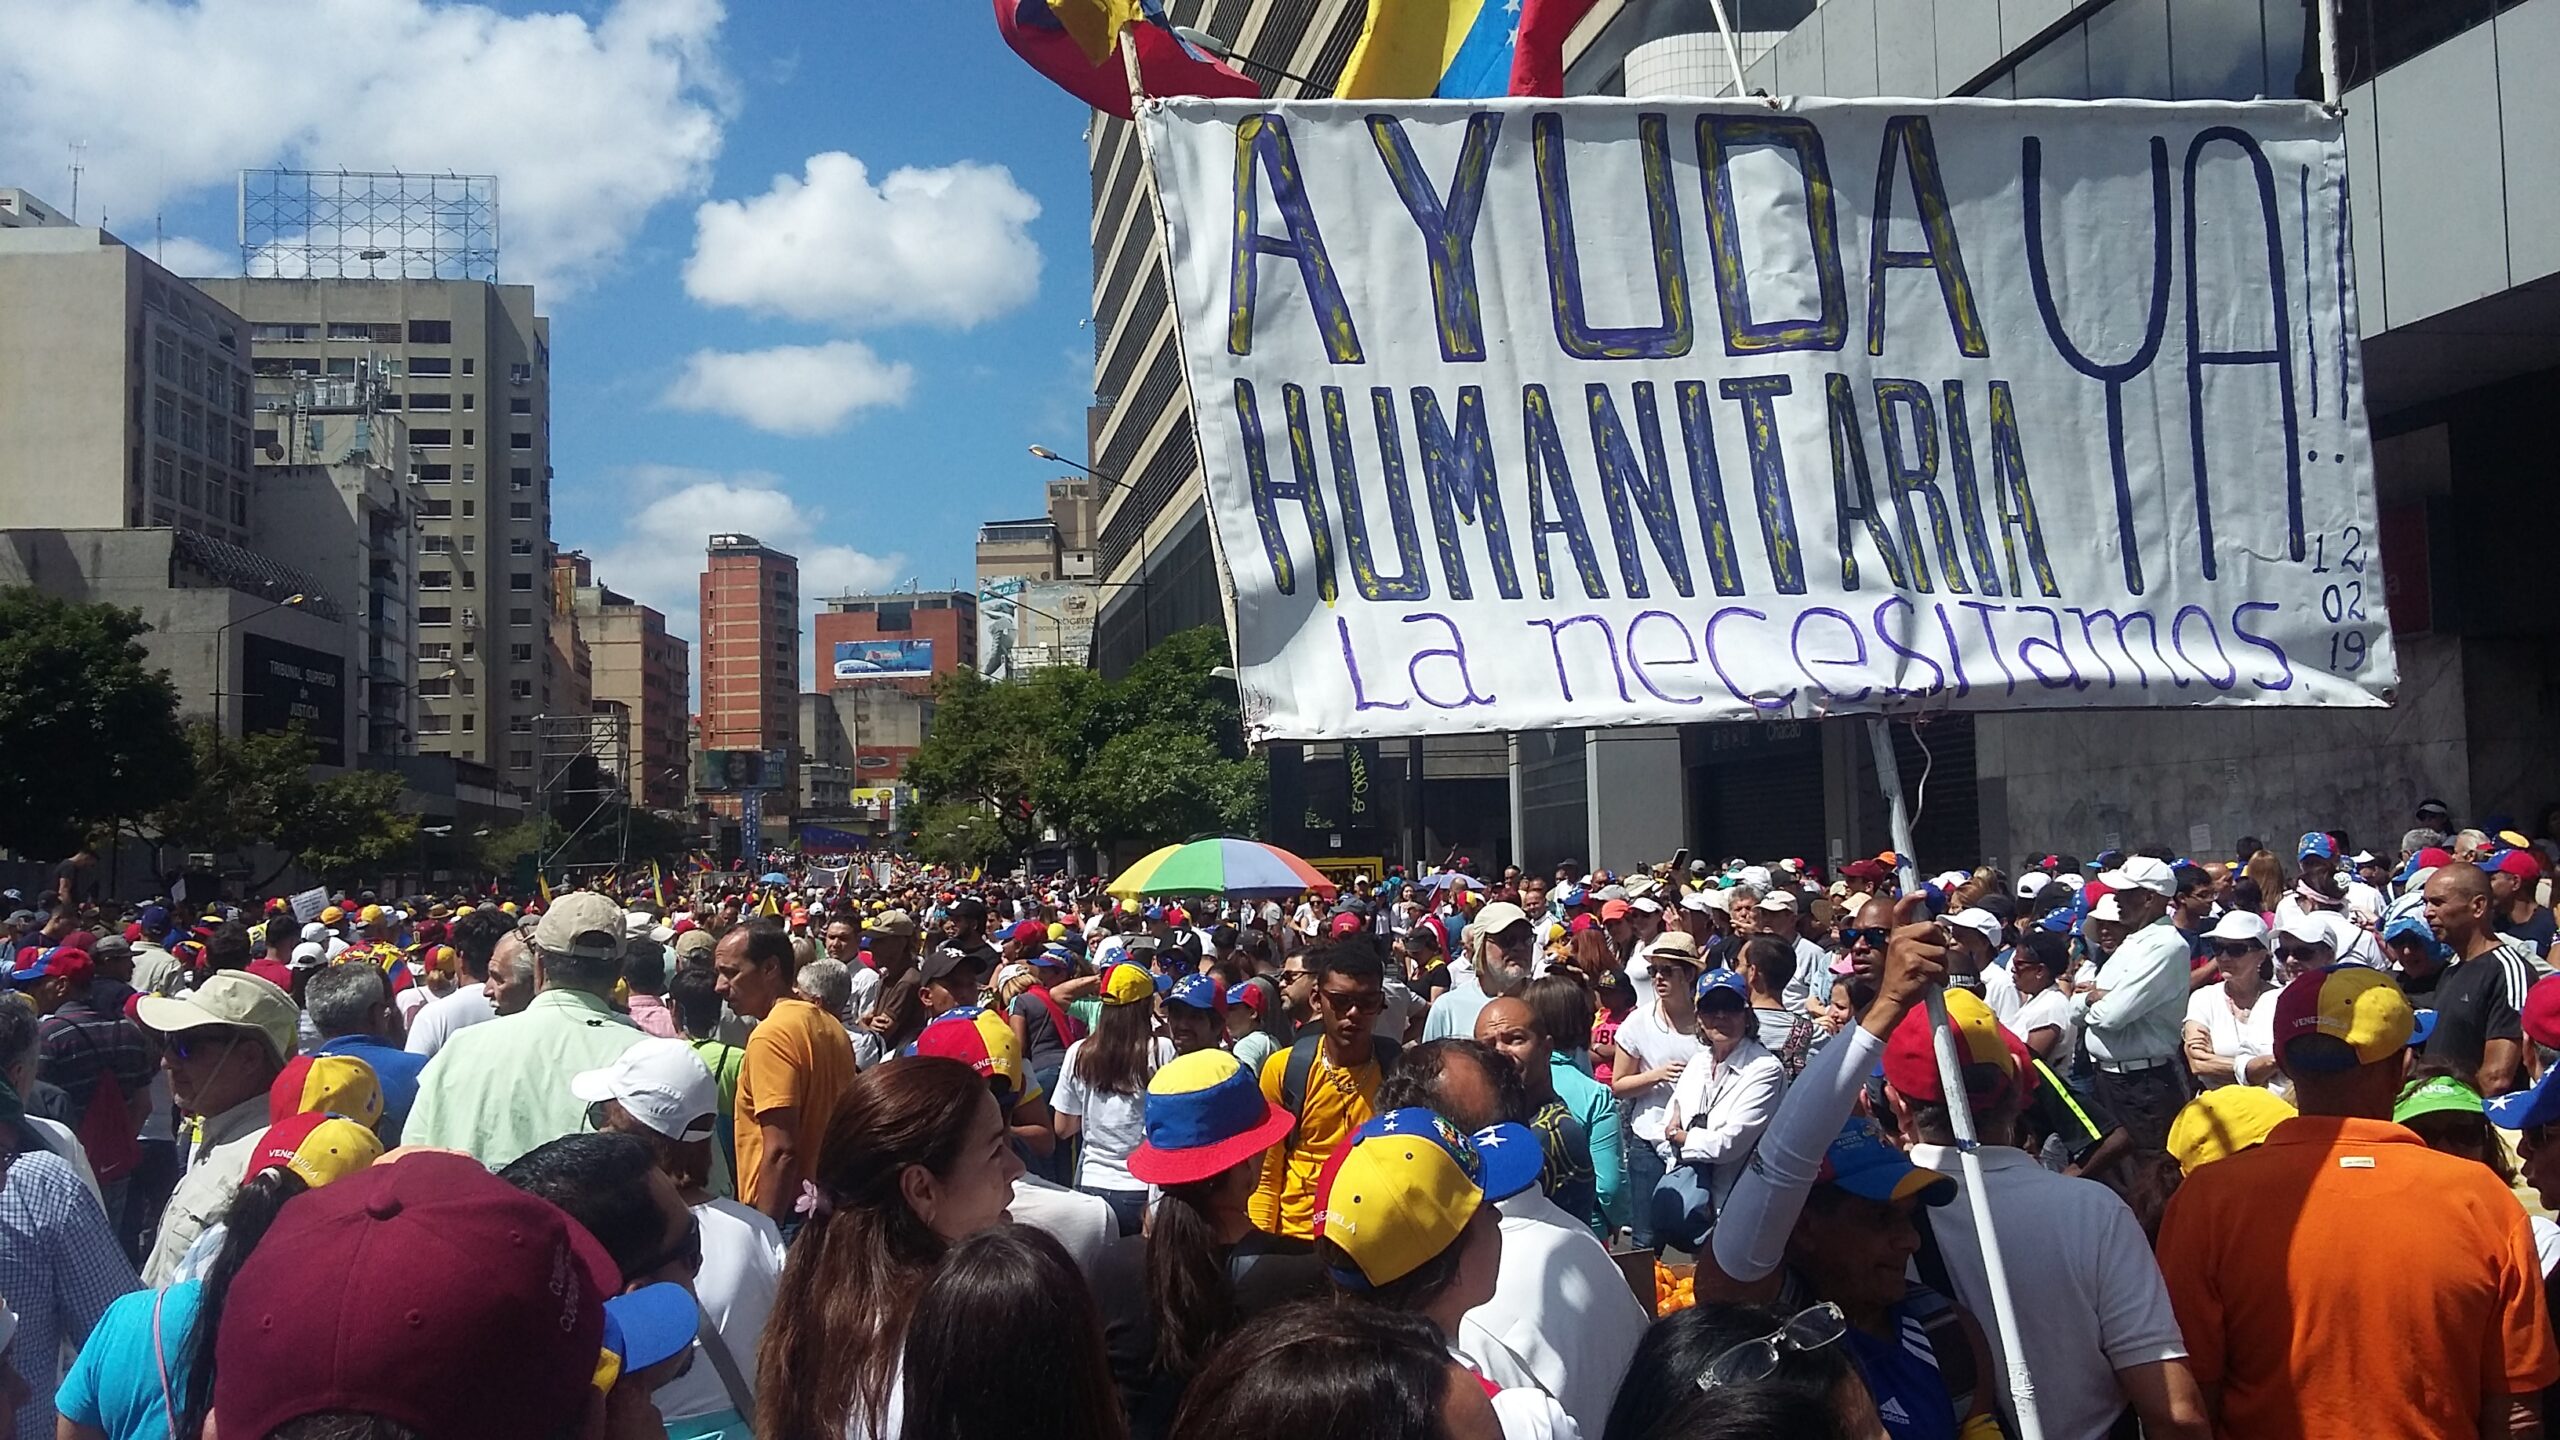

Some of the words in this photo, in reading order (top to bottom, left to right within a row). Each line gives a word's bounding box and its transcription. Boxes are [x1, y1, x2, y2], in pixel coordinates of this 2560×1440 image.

[1227, 112, 1989, 364] AYUDA
[1235, 373, 2061, 606] HUMANITARIA
[2322, 580, 2367, 623] 02
[1337, 612, 1496, 711] La
[2330, 630, 2366, 671] 19
[269, 660, 303, 680] TRIBUNAL
[305, 668, 336, 688] SUPREMO
[290, 701, 320, 720] JUSTICIA
